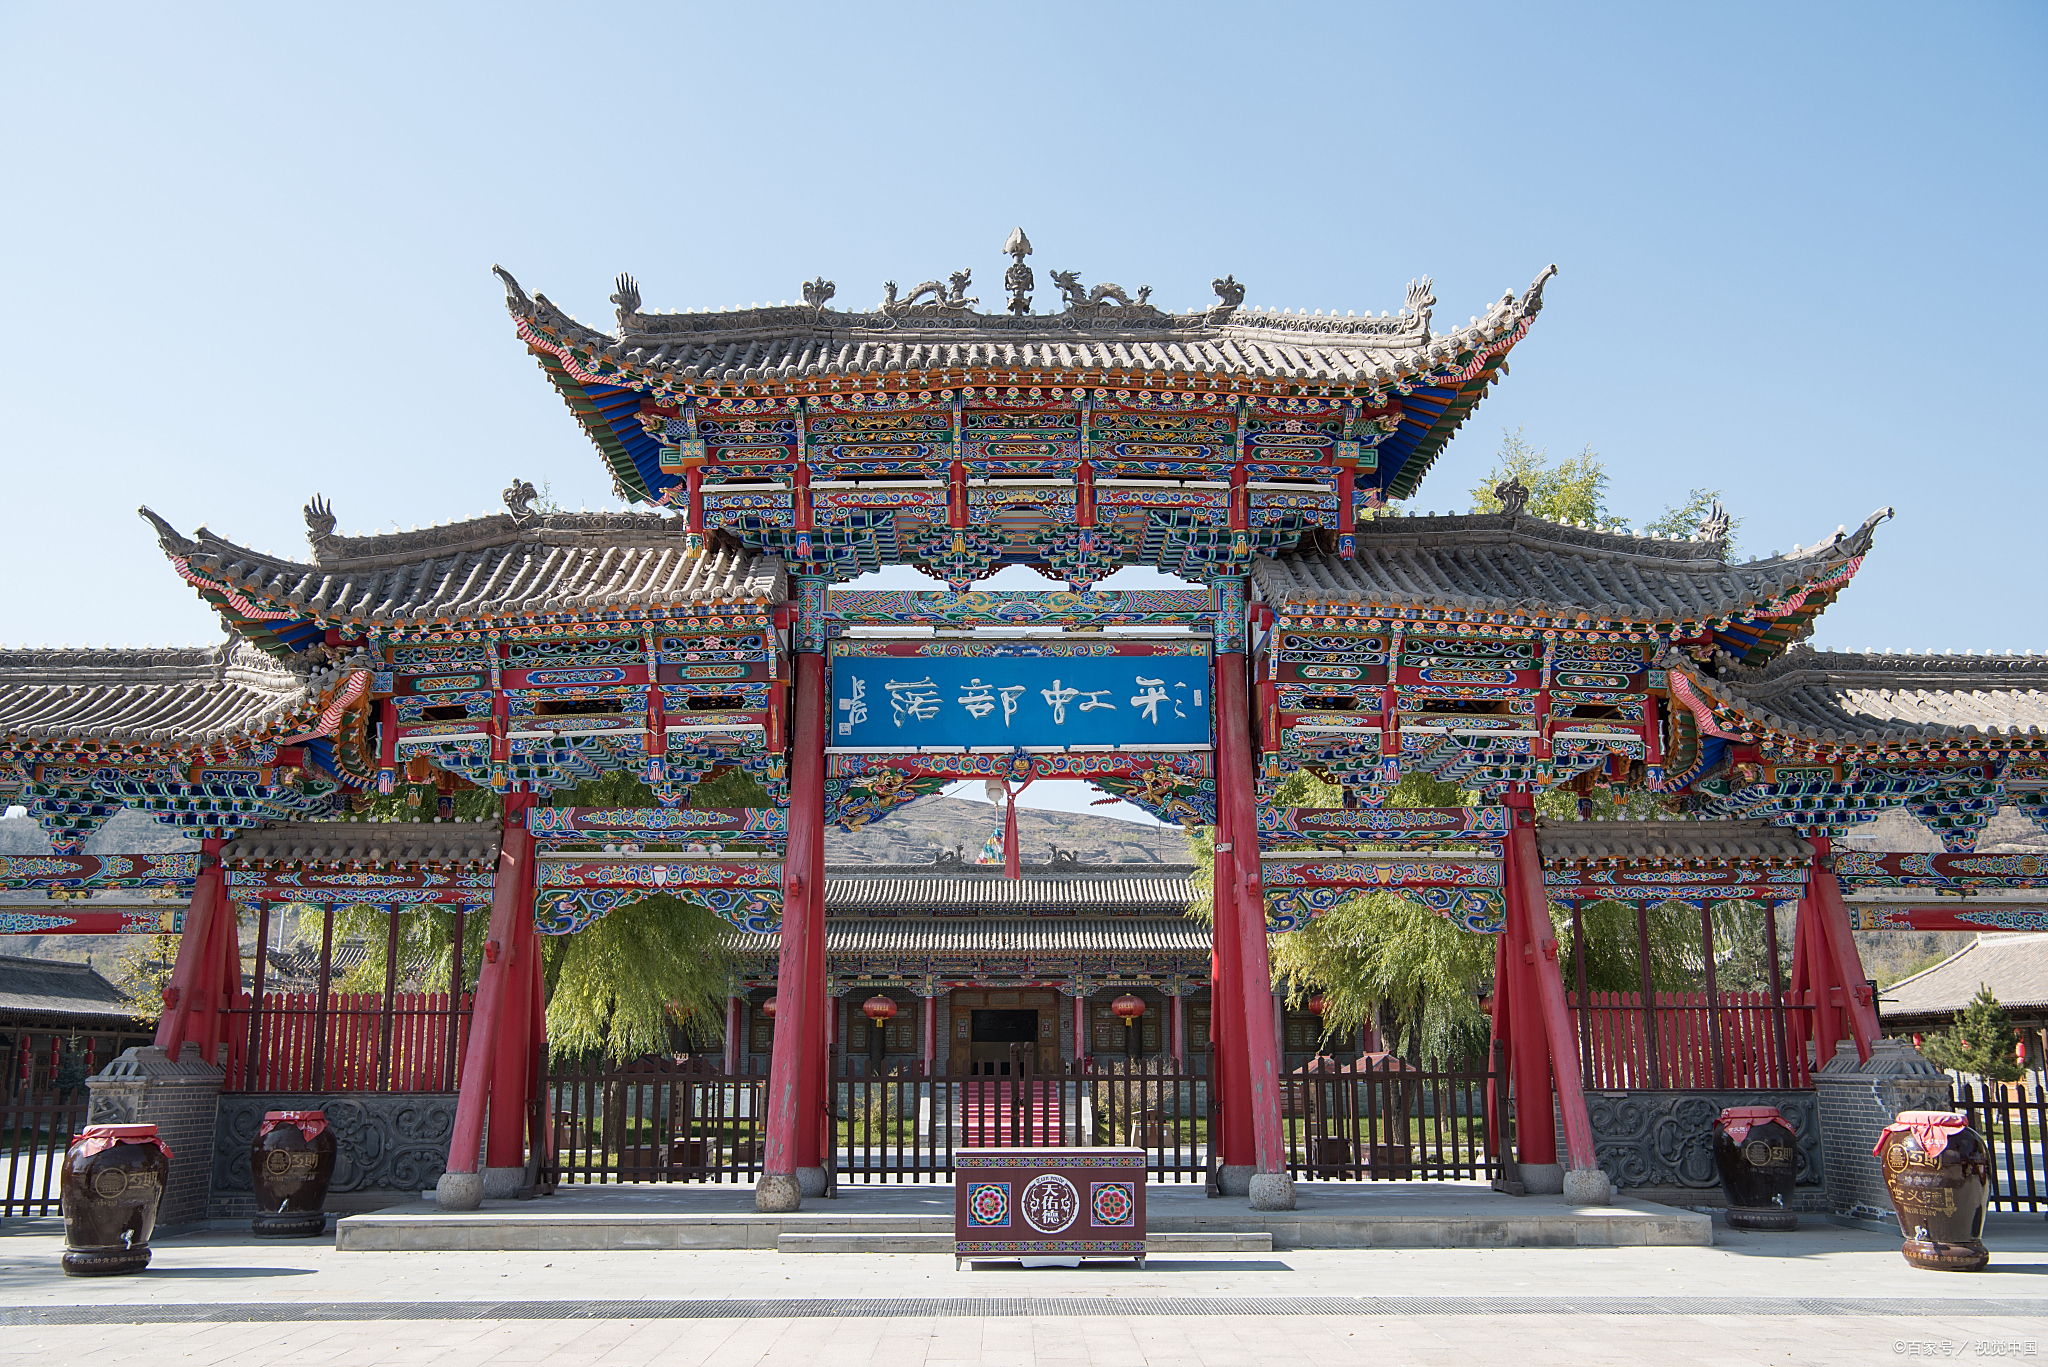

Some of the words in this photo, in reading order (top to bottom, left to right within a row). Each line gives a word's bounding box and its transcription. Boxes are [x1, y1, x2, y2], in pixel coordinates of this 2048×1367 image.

[884, 675, 1188, 729] 彩虹部落
[1041, 1183, 1060, 1225] 天佑德
